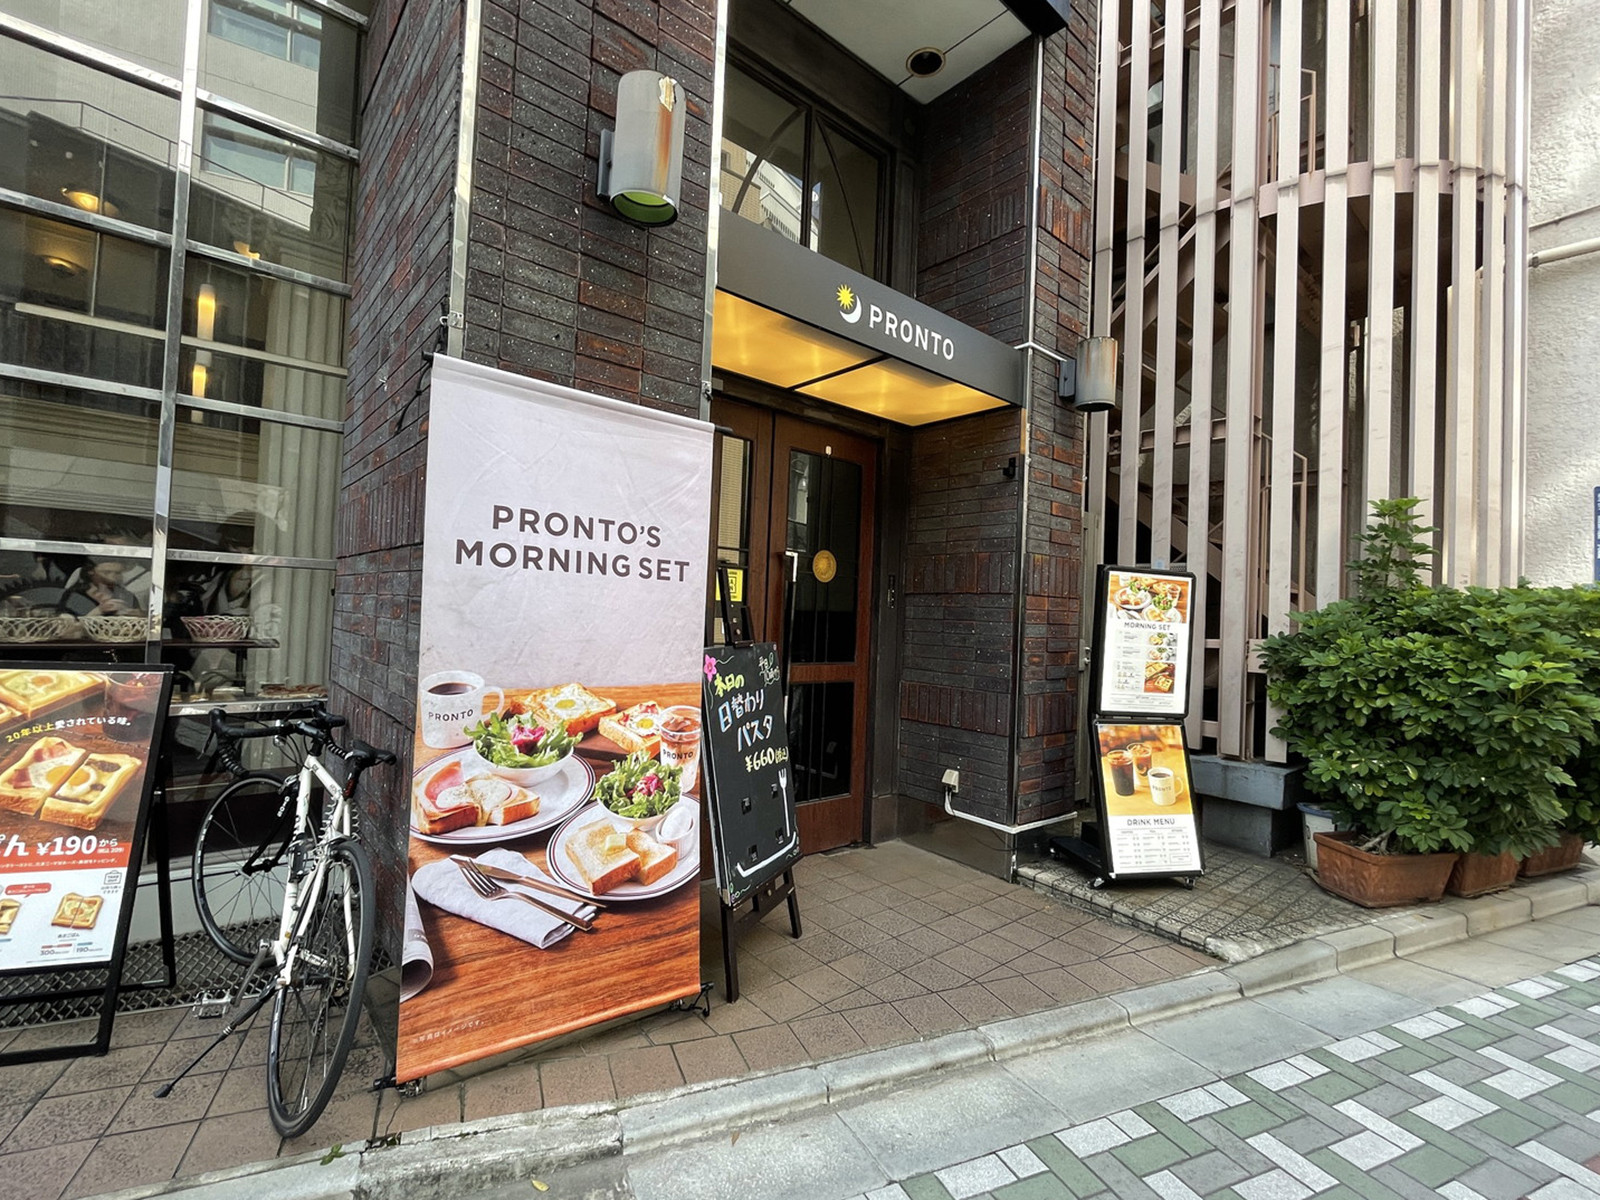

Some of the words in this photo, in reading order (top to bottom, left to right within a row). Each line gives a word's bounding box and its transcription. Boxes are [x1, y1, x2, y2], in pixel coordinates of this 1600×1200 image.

[869, 304, 954, 361] PRONTO
[492, 504, 662, 549] PRONTO'S
[455, 539, 631, 578] MORNING
[638, 557, 690, 582] SET
[1124, 622, 1157, 630] MORNING
[714, 673, 745, 698] 本日の
[428, 708, 474, 721] PRONTO
[718, 688, 765, 733] 日替わり
[737, 714, 773, 752] パスタ
[662, 748, 694, 760] PRONTO
[1127, 818, 1151, 826] DRINK
[1153, 818, 1175, 826] MENU
